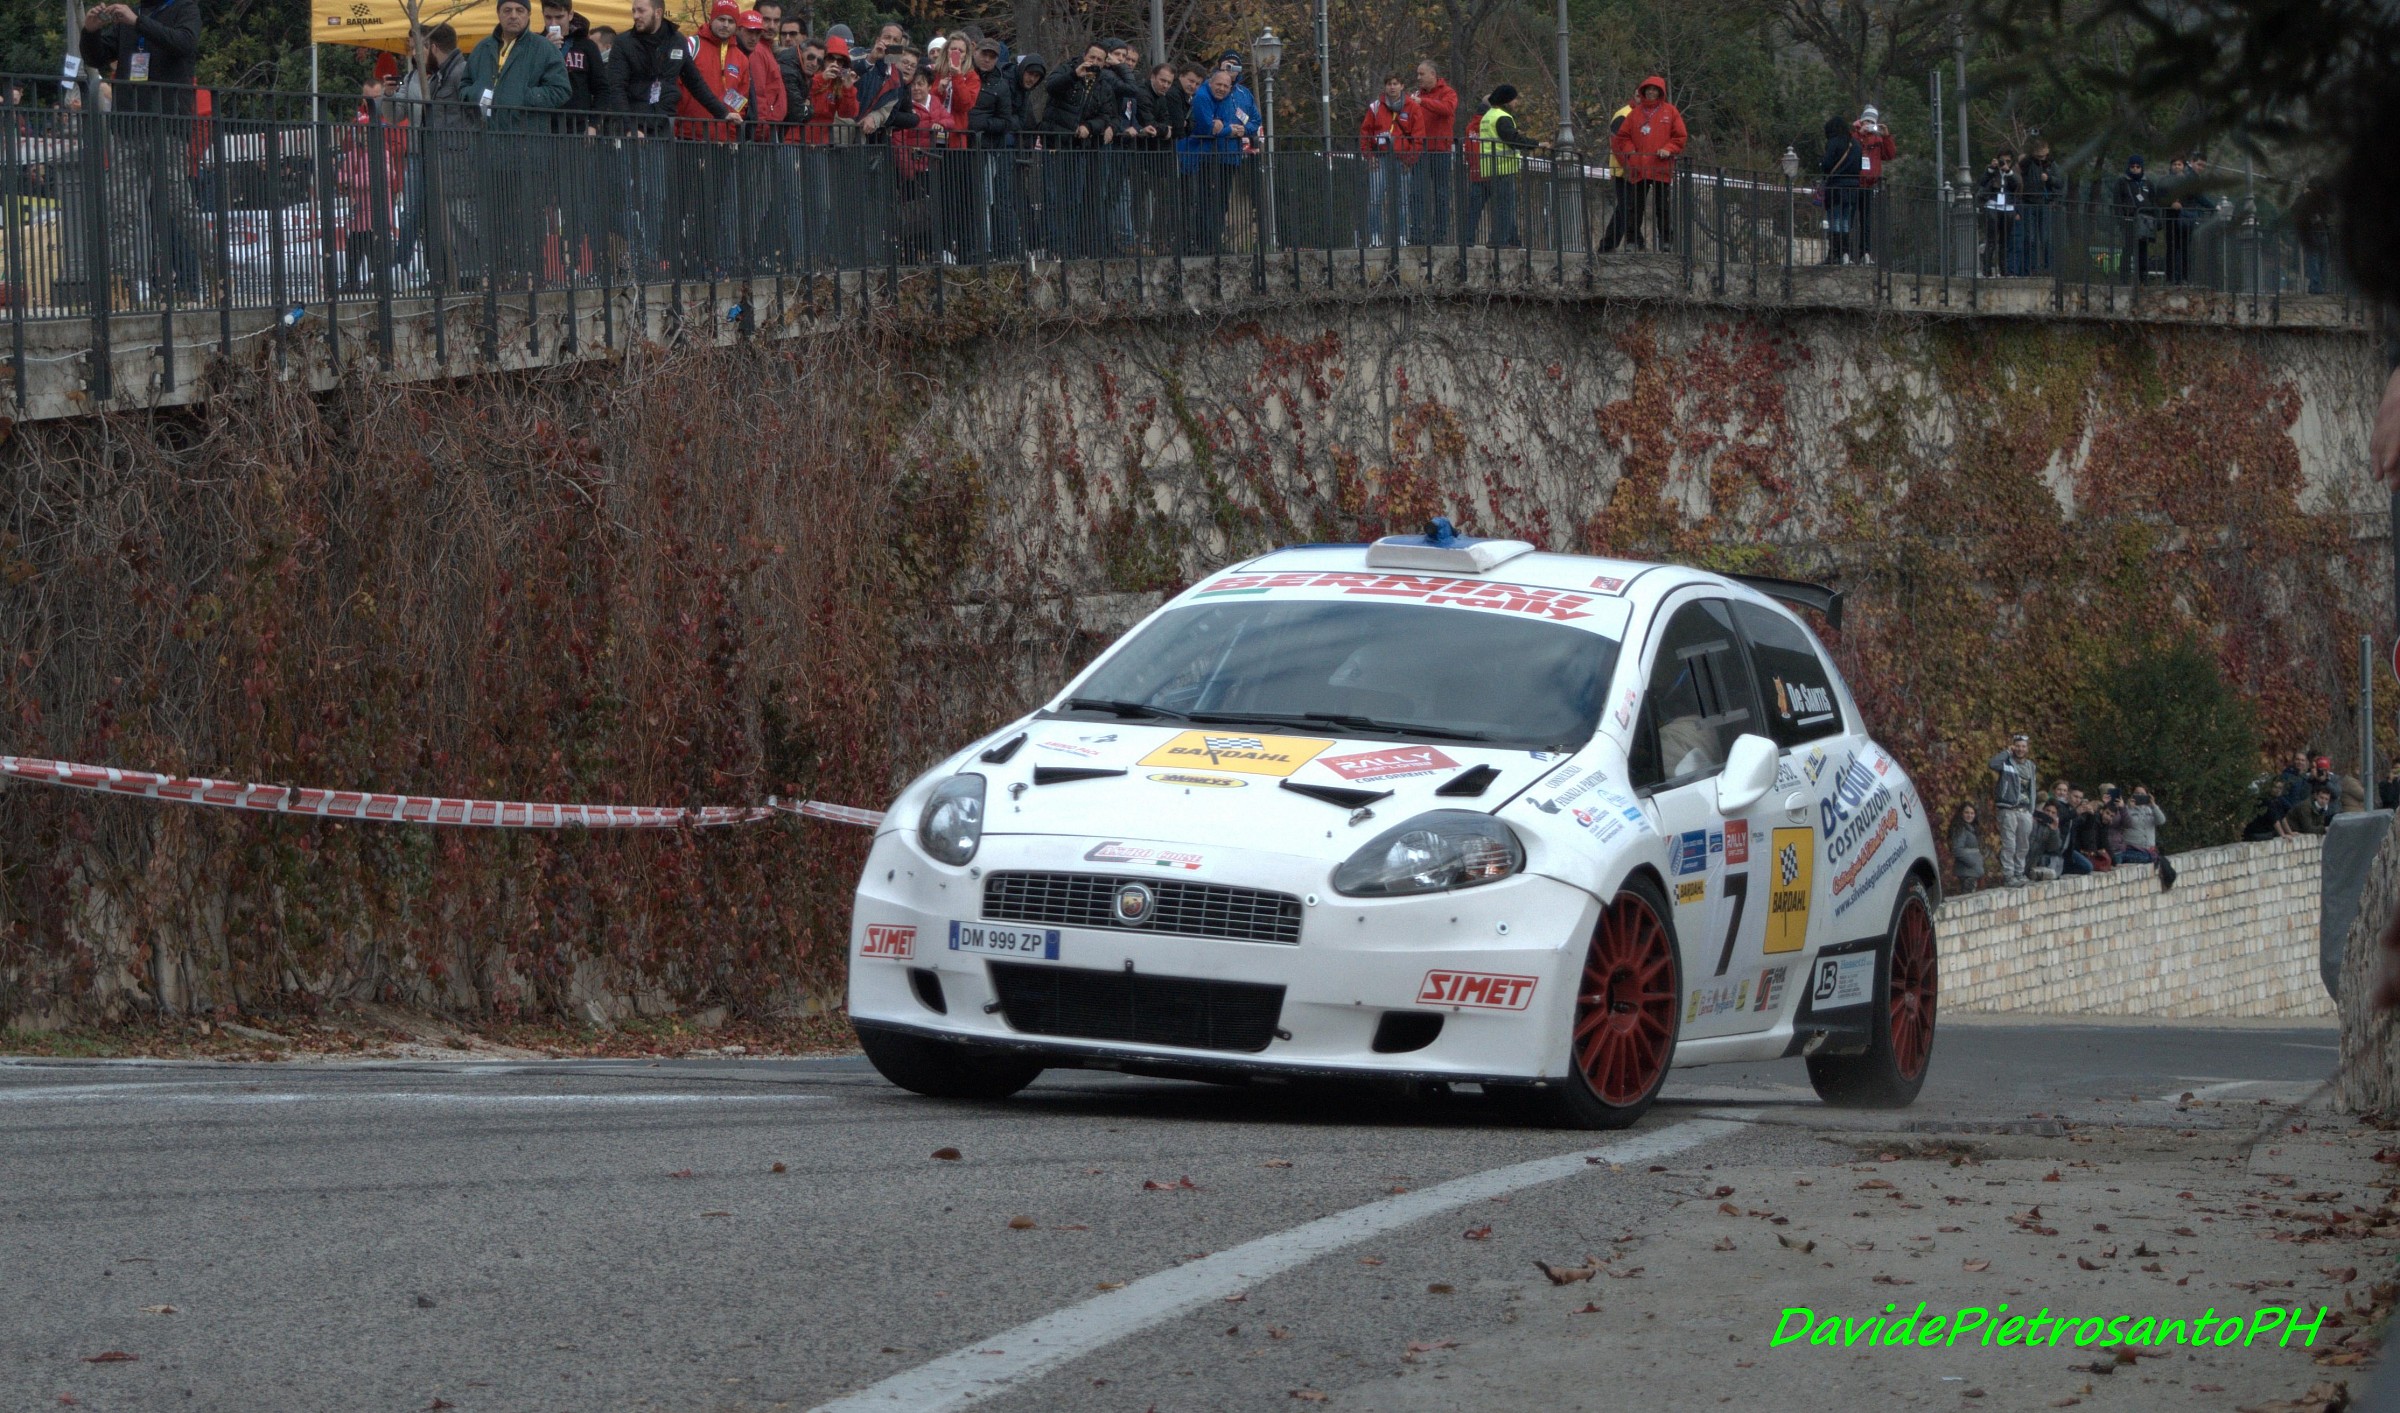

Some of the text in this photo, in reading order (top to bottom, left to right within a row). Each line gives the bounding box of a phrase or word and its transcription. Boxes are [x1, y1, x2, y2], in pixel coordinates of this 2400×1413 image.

[1786, 683, 1805, 712] De
[1167, 746, 1291, 763] BARDAHL
[1336, 752, 1432, 771] RALLY
[1355, 770, 1436, 783] CONCORRENTE
[1545, 765, 1583, 788] CONSULENZA
[1555, 787, 1583, 807] FINANZA
[1828, 782, 1891, 864] COSTRUZIONI
[1727, 831, 1747, 848] RALLY
[1680, 880, 1704, 898] BARDAHL
[1772, 890, 1806, 913] BARDAHL
[1714, 872, 1748, 976] 7
[864, 927, 916, 956] SIMET
[962, 928, 1042, 952] DM 999 ZP
[1421, 974, 1533, 1005] SIMET
